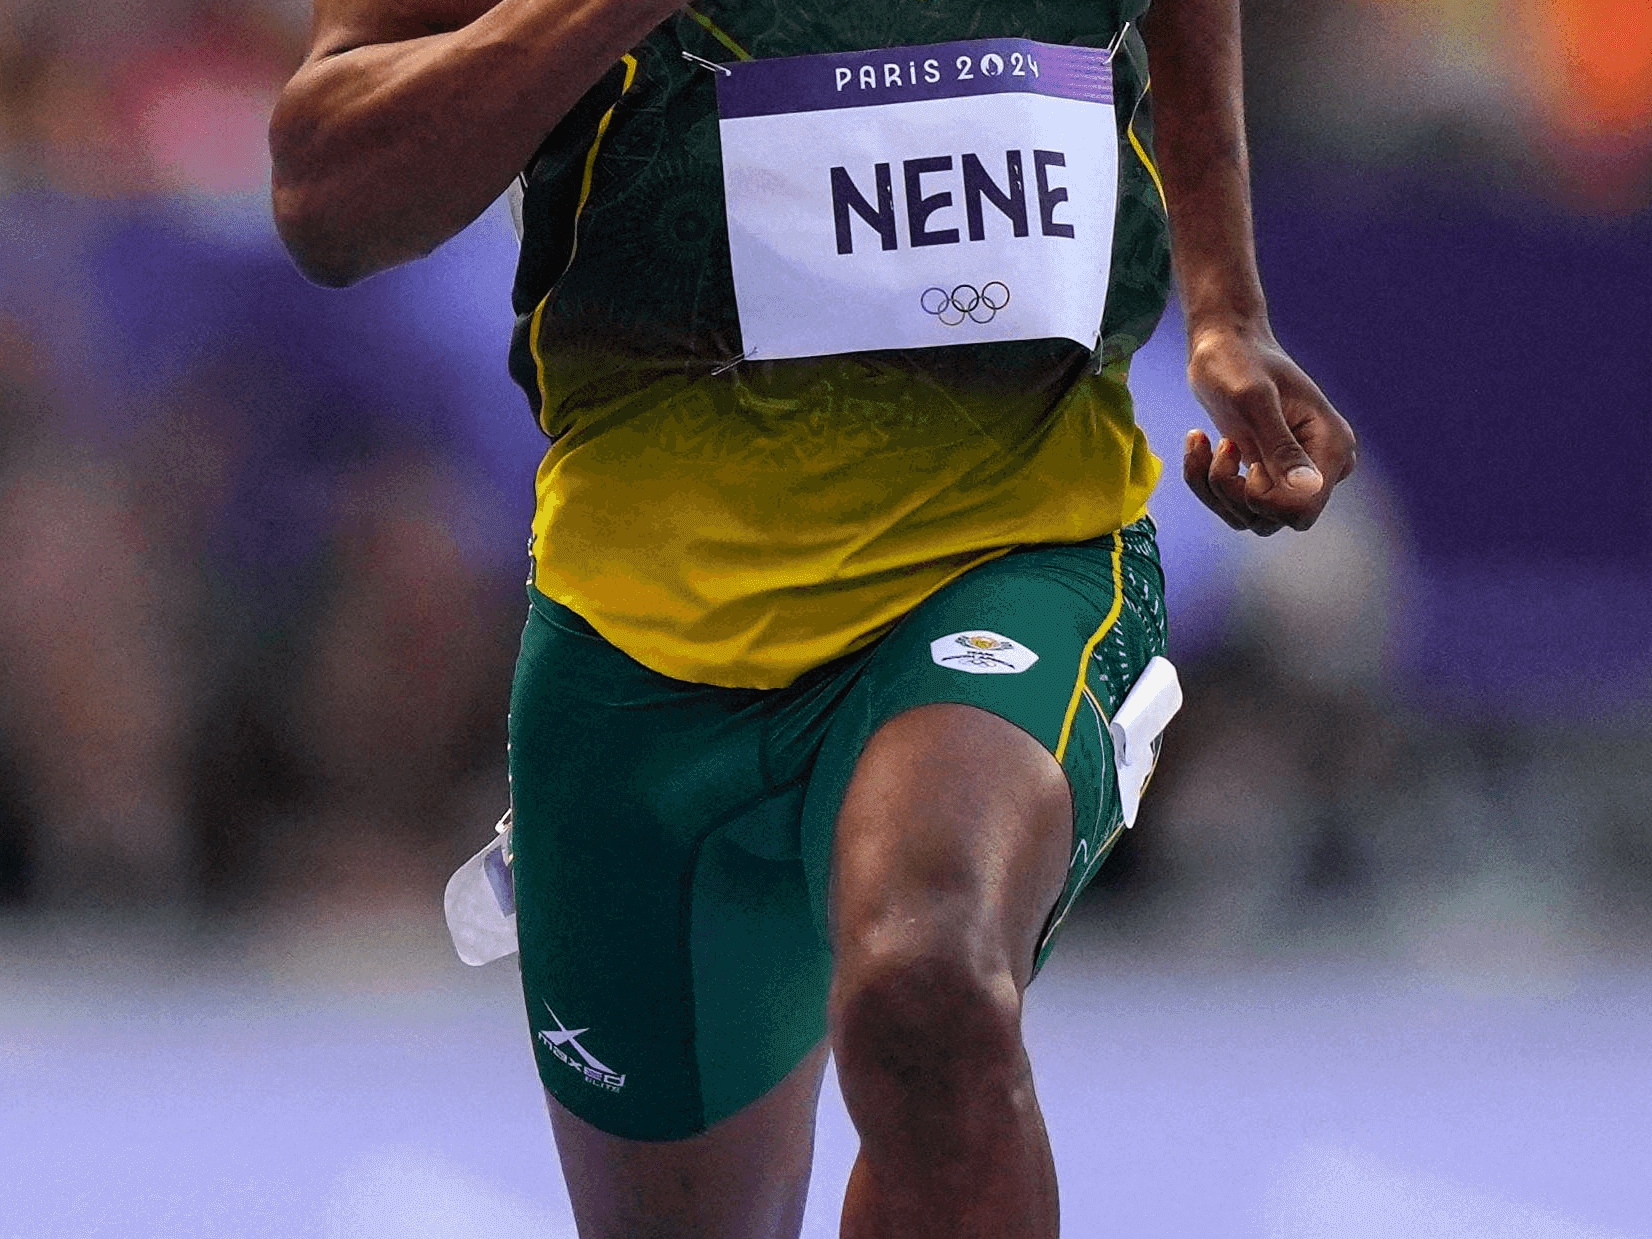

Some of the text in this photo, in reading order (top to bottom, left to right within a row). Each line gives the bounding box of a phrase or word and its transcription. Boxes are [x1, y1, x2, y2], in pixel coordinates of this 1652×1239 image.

[834, 53, 1040, 92] PARIS 2024
[830, 149, 1075, 255] NENE
